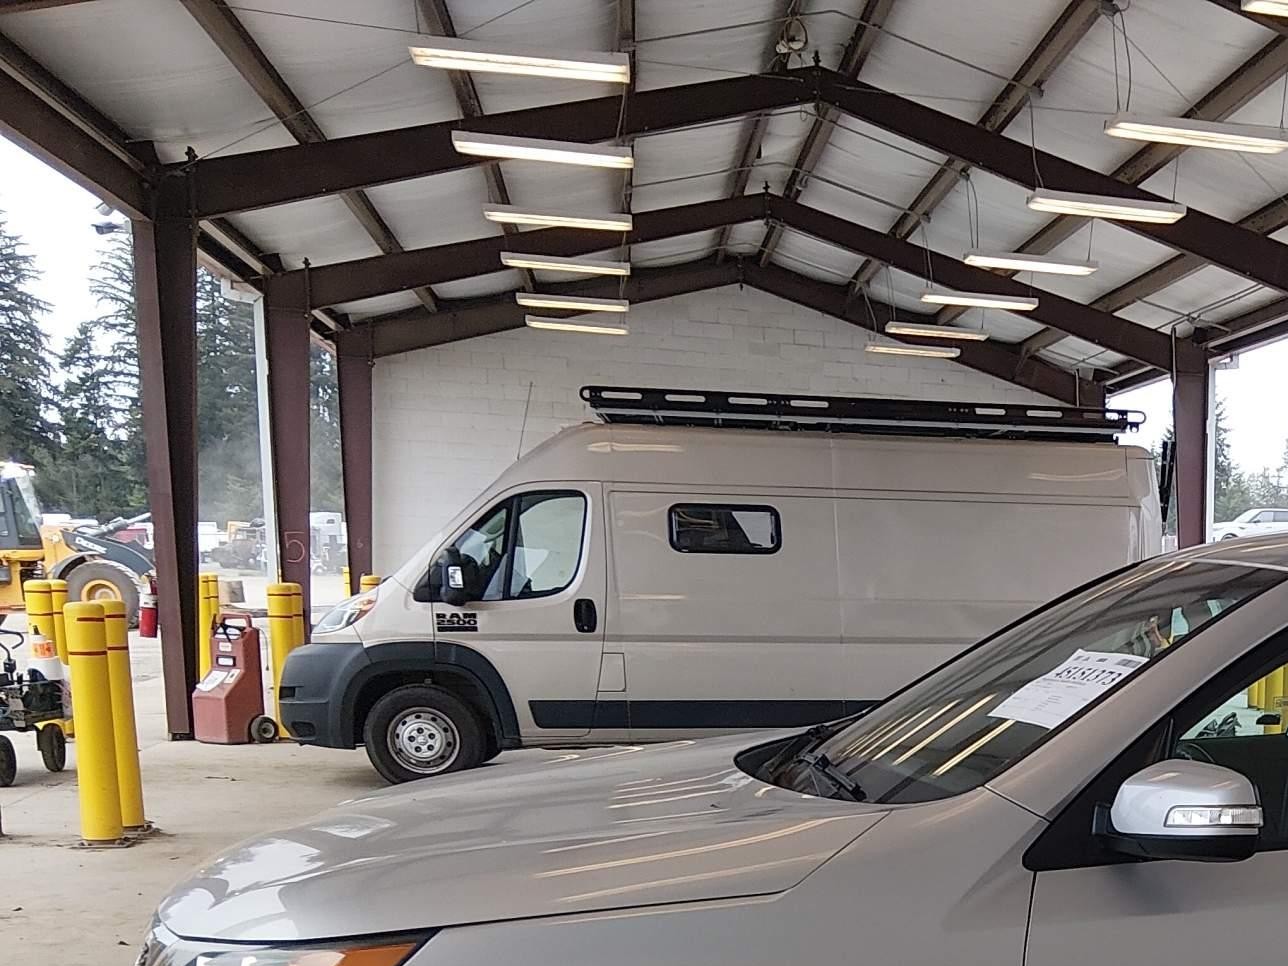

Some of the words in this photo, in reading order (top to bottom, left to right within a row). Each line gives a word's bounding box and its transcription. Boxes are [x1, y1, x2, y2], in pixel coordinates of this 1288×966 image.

[284, 531, 305, 563] 5
[436, 612, 477, 620] RAM
[1055, 666, 1123, 686] 45151373
